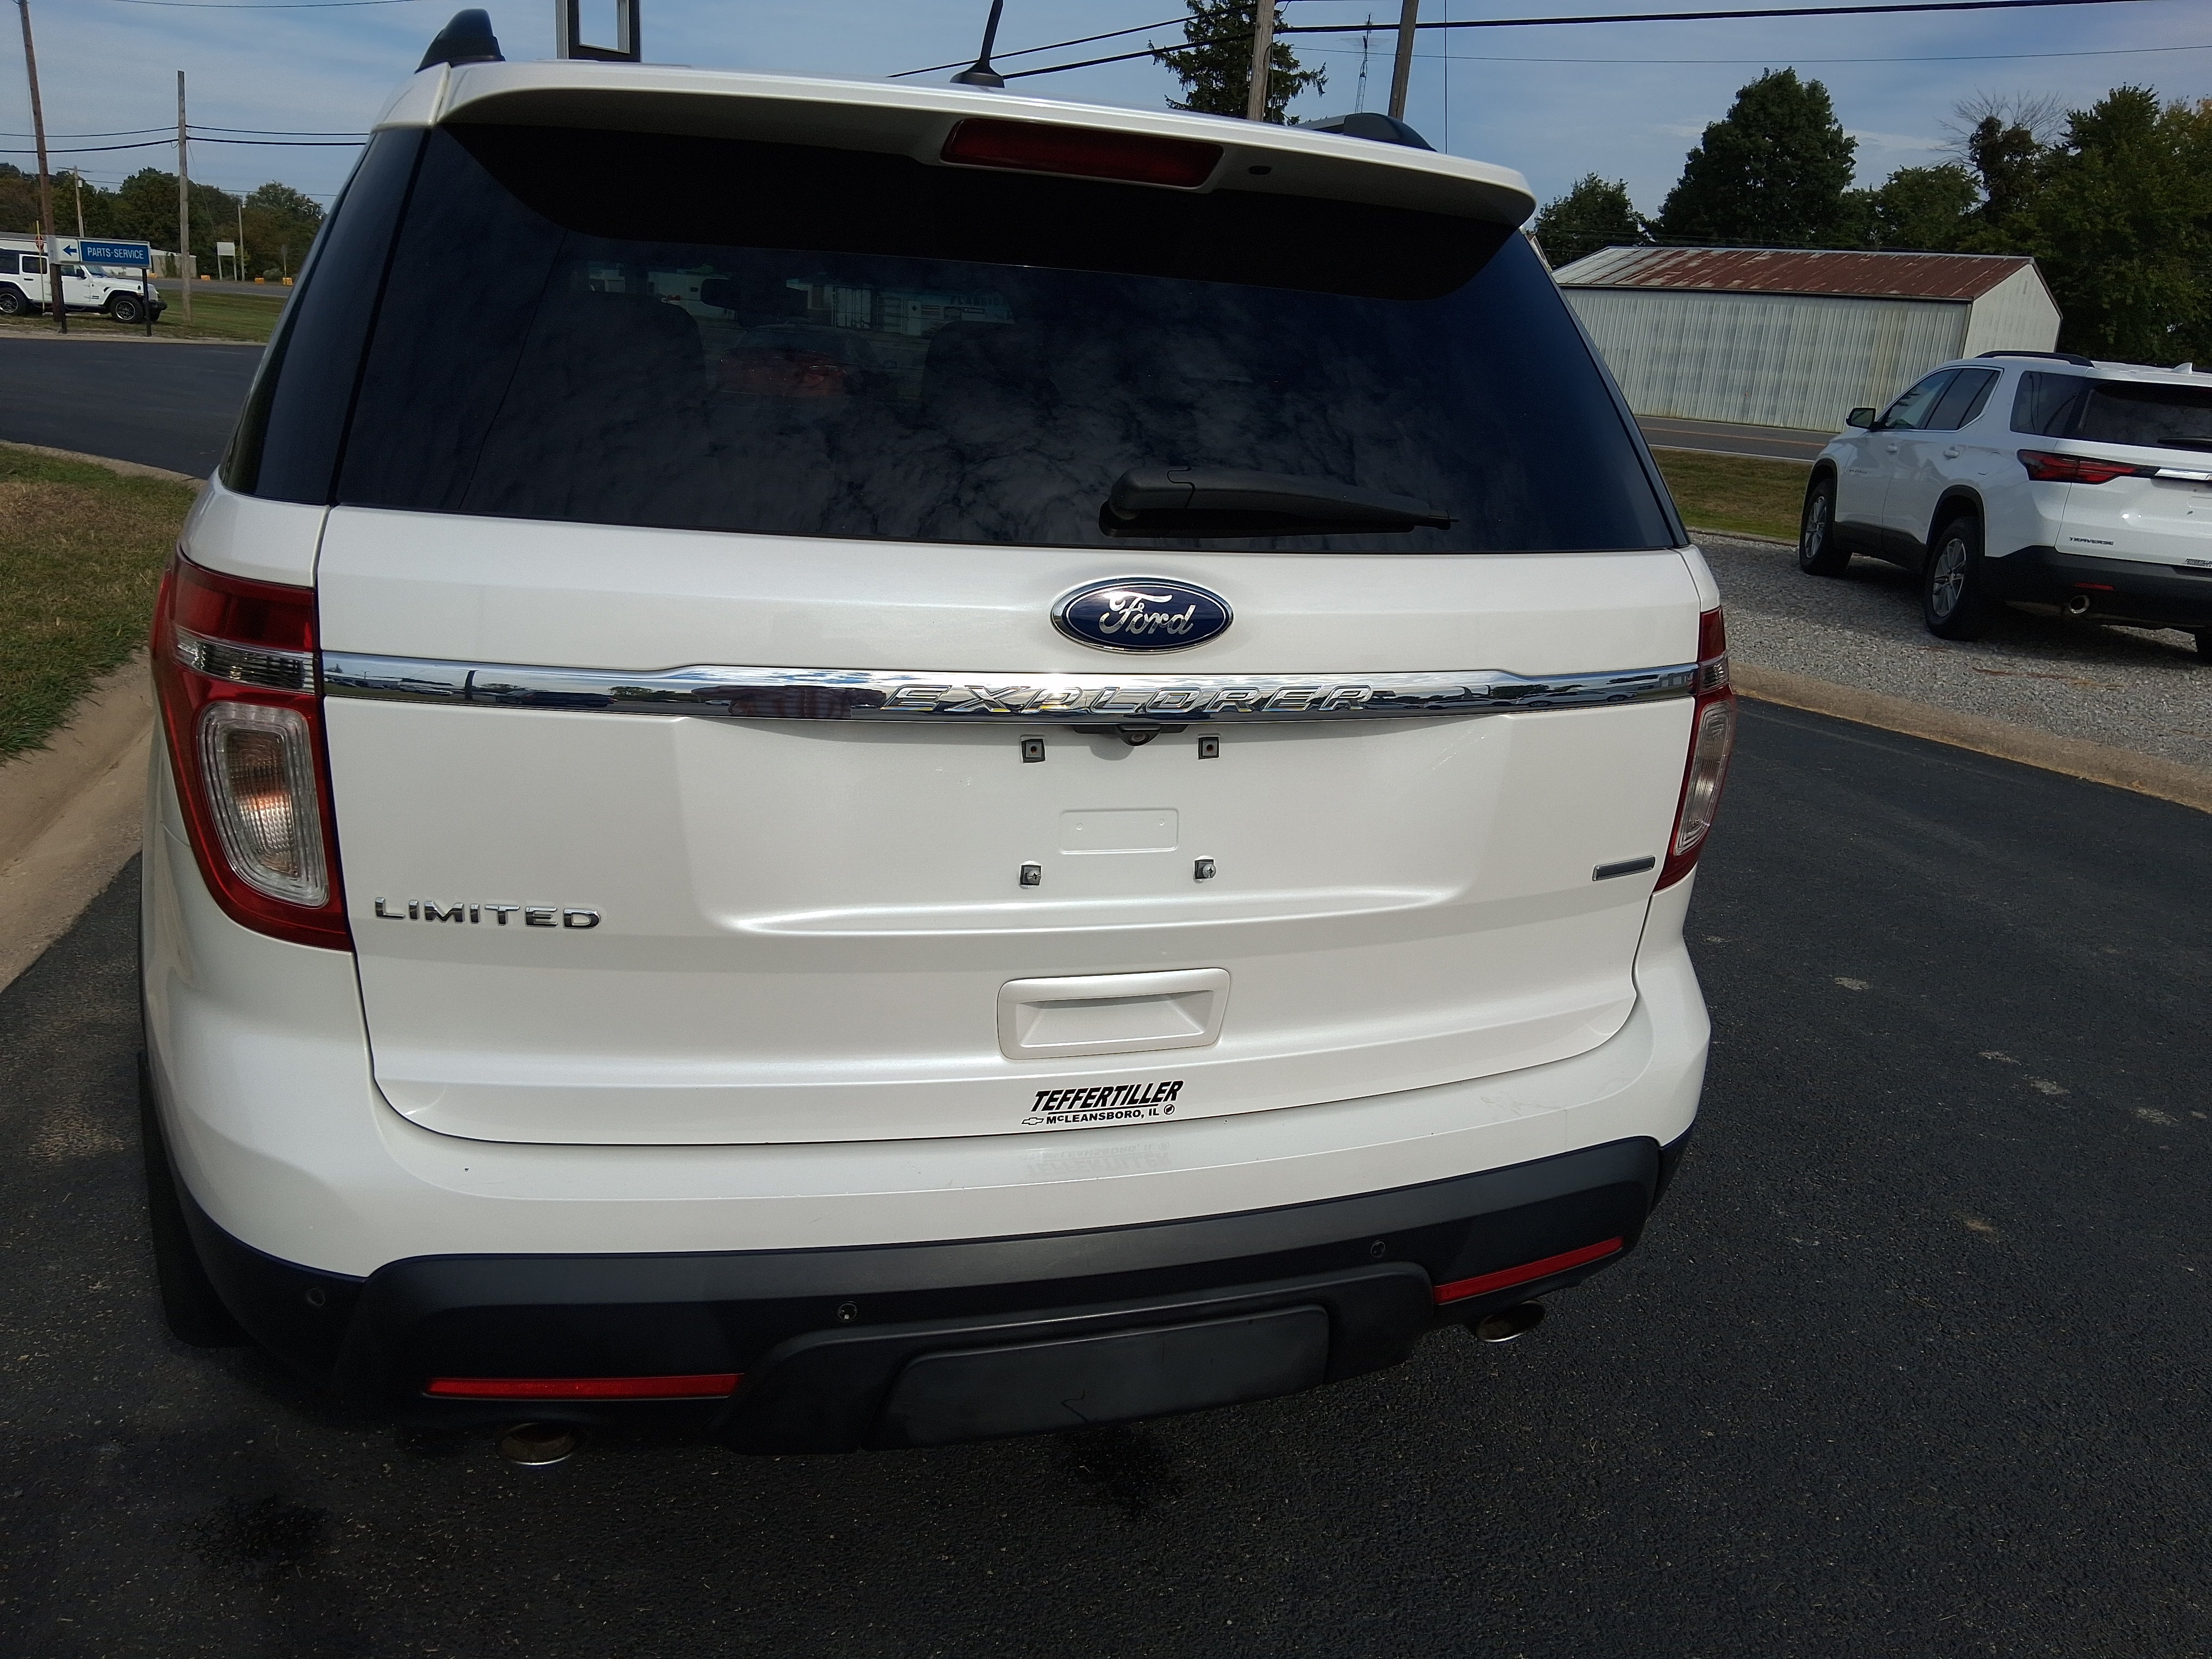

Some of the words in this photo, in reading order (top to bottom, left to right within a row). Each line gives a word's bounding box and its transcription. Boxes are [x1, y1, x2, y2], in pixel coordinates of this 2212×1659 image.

[87, 247, 144, 259] PARTS-SERVICE
[1098, 590, 1197, 635] Ford
[879, 684, 1373, 714] EXPLORER
[375, 897, 600, 928] LIMITED
[1031, 1080, 1184, 1112] TEFFERTILLER
[1148, 1108, 1160, 1116] IL
